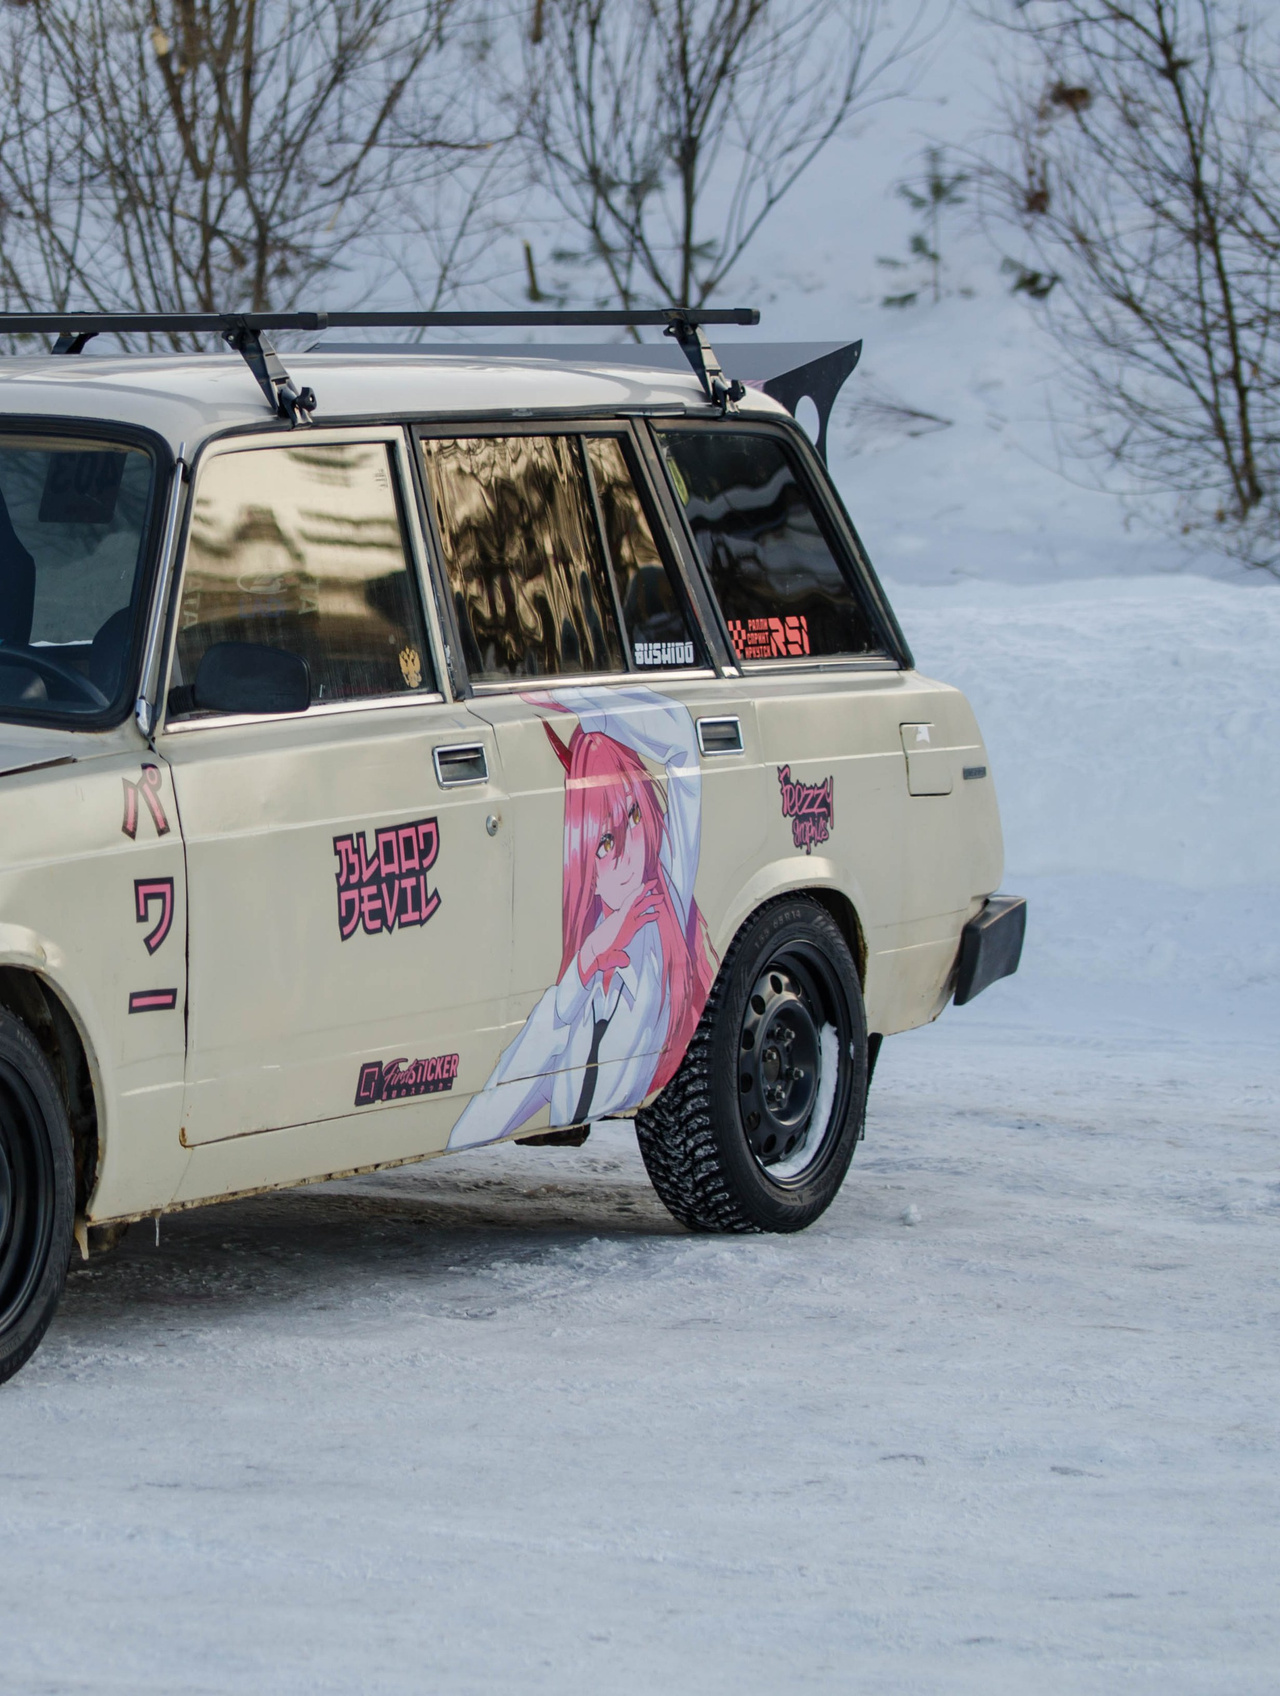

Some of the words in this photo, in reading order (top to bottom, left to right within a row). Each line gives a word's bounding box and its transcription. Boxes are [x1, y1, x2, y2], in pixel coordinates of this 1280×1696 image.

[634, 641, 694, 665] BUSHIDO
[768, 615, 810, 658] RSI
[333, 816, 441, 887] BLOOD
[337, 874, 442, 942] DEVIL
